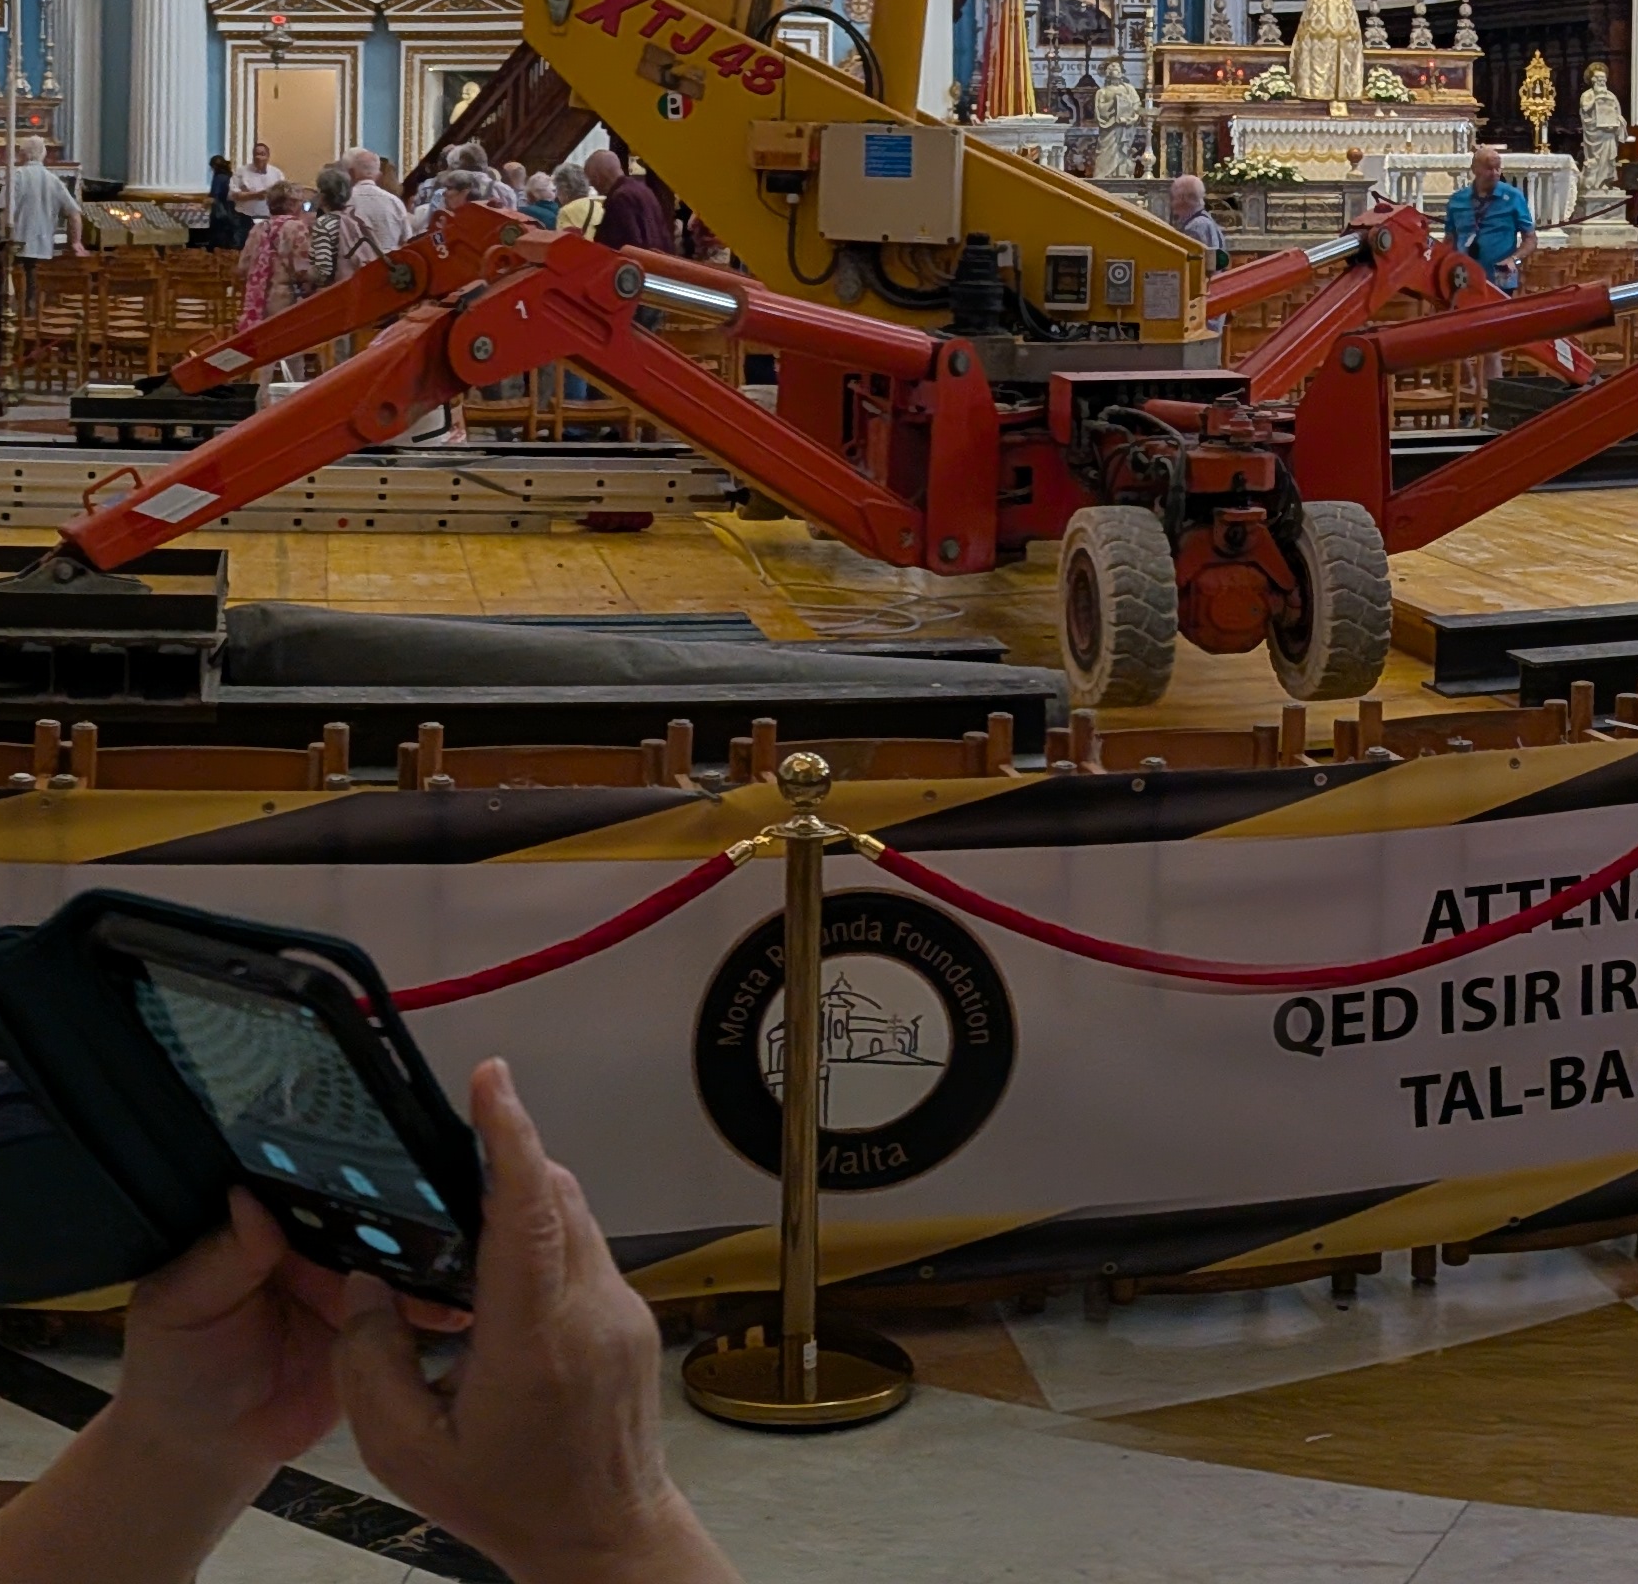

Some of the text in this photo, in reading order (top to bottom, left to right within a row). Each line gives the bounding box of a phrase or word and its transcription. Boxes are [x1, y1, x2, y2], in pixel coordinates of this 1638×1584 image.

[709, 43, 787, 96] 48
[515, 300, 528, 319] 1
[718, 967, 771, 1047] Mosta
[893, 922, 991, 1046] Foundation
[1273, 987, 1419, 1057] QED
[1440, 970, 1561, 1035] ISIR
